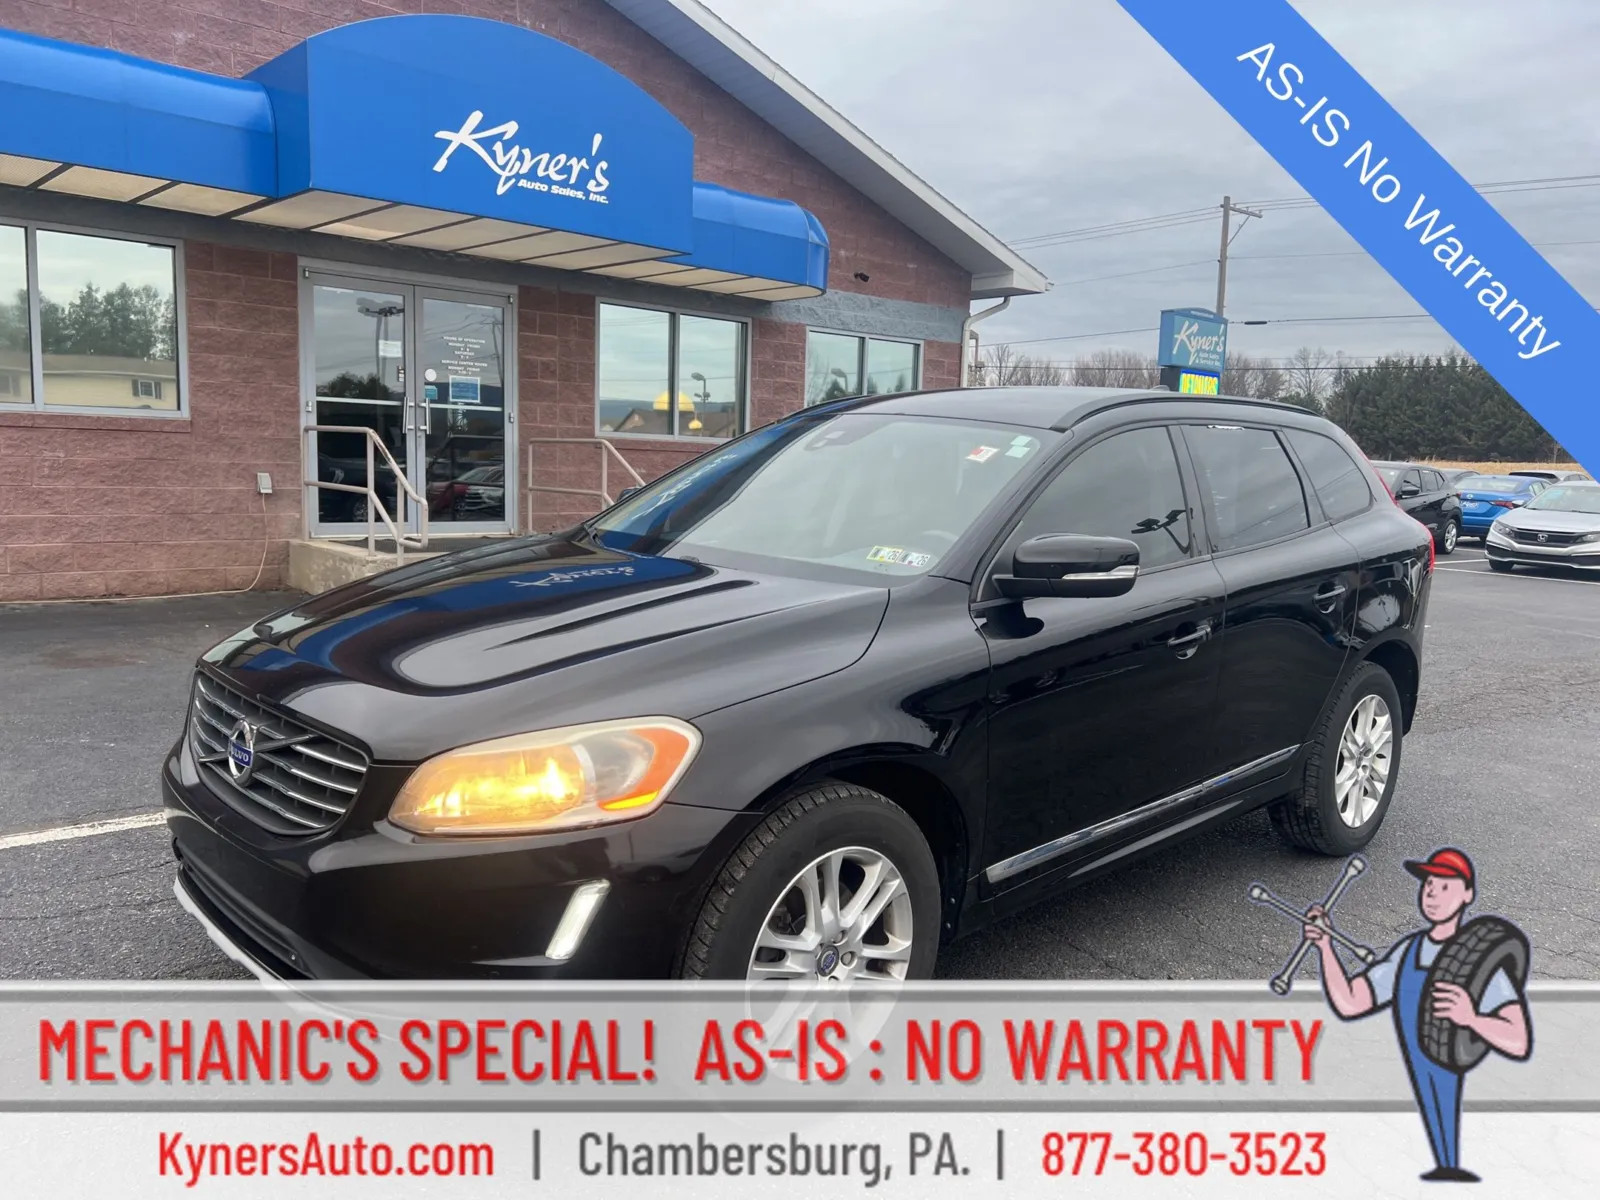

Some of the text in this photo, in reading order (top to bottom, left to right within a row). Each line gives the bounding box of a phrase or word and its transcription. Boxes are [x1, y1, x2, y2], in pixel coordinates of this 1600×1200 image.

[432, 110, 609, 196] Kyner's
[517, 178, 609, 204] Auto Sales, Inc.
[1173, 320, 1225, 366] Kyner's
